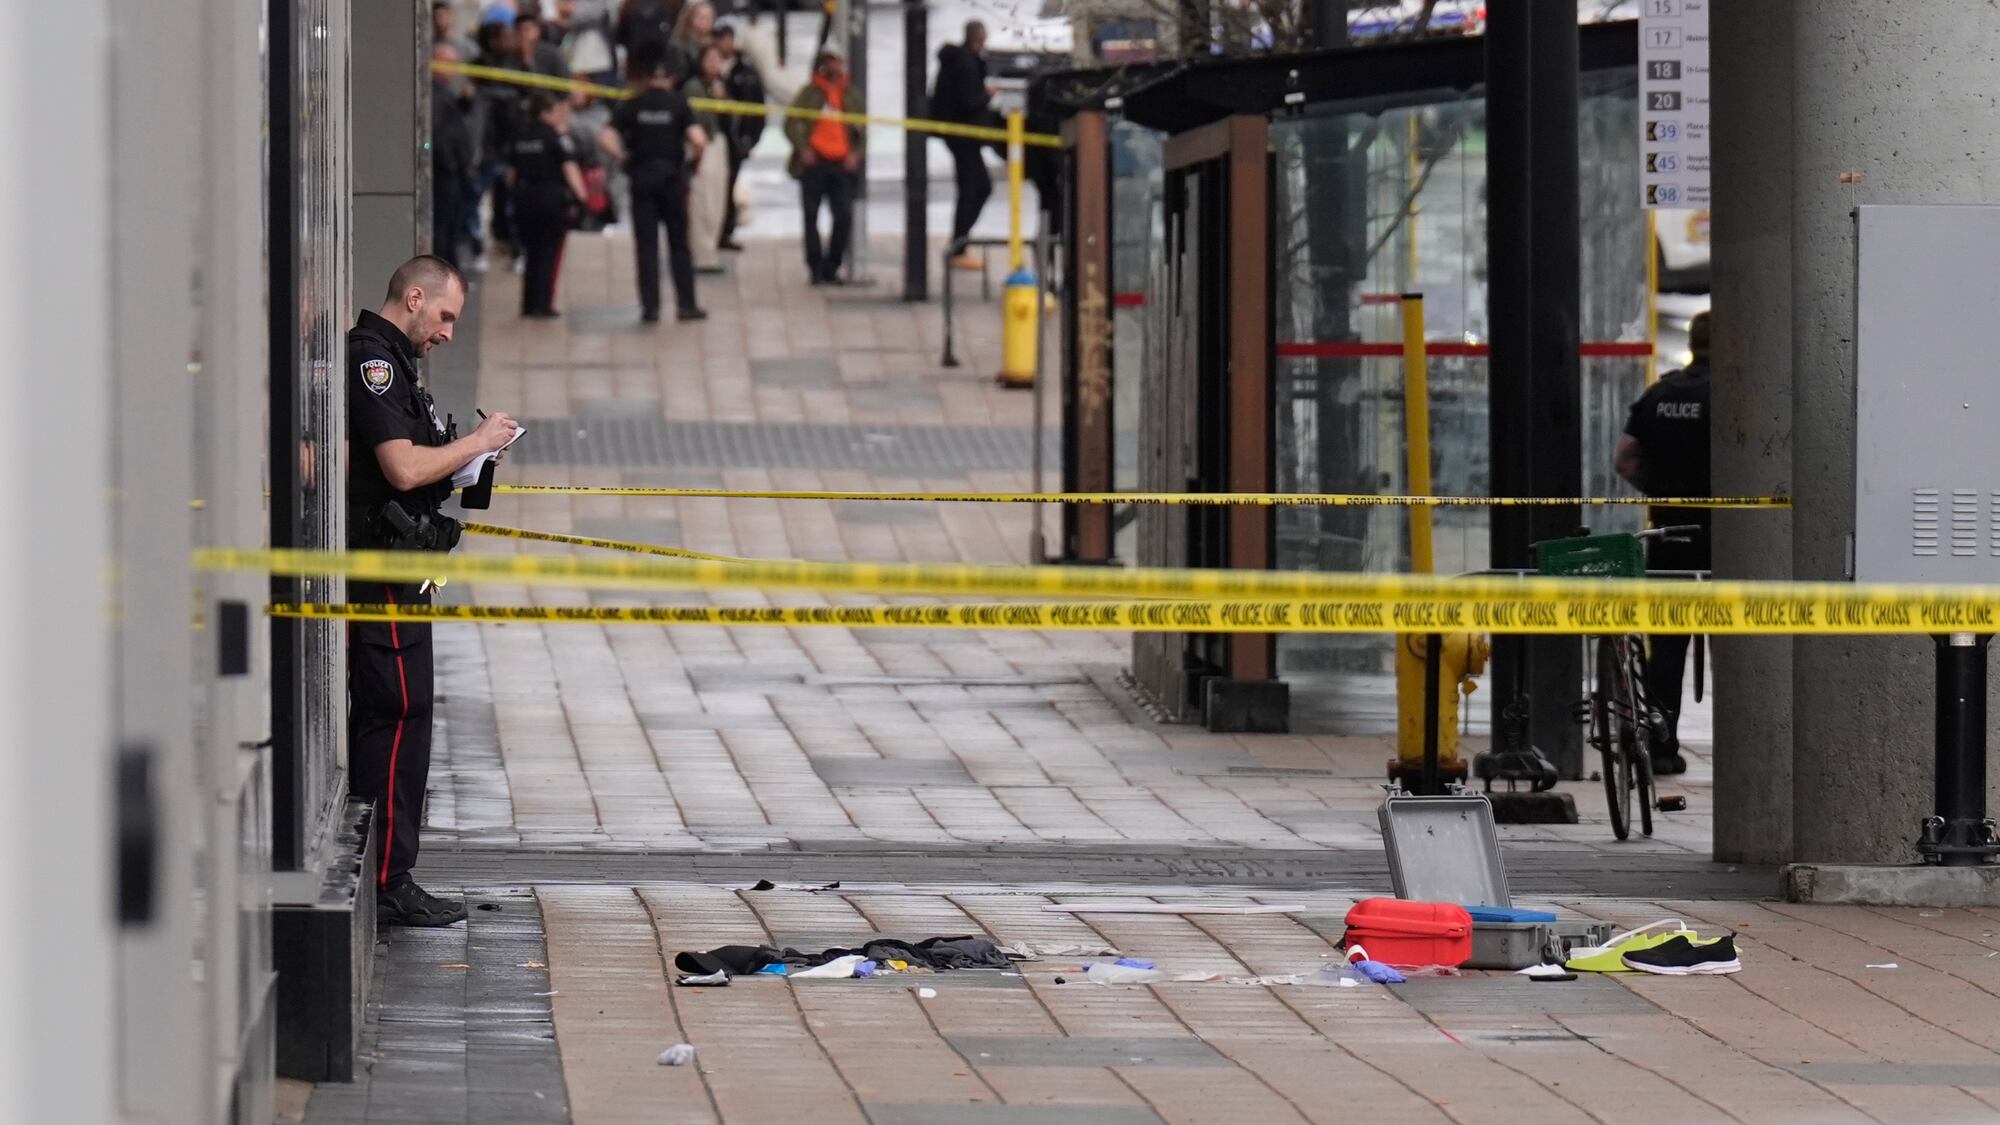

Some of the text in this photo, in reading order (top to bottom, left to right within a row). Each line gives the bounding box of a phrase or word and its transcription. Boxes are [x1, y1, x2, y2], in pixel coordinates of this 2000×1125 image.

[1654, 0, 1671, 13] 15
[1654, 31, 1671, 45] 17
[1653, 63, 1672, 78] 18
[1654, 93, 1673, 109] 20
[1658, 123, 1676, 138] 39
[1658, 155, 1676, 170] 45
[1658, 187, 1676, 202] 98
[365, 361, 389, 369] POLICE
[1656, 402, 1701, 419] POLICE
[1128, 605, 1146, 625] DO
[1147, 604, 1172, 625] NOT
[1173, 604, 1211, 625] CROSS
[1220, 603, 1263, 625] POLICE
[1263, 603, 1291, 625] LINE
[1300, 603, 1316, 625] DO
[1319, 603, 1343, 625] NOT
[1345, 603, 1383, 626] CROSS
[1393, 602, 1436, 626] POLICE
[1436, 602, 1464, 626] LINE
[1472, 602, 1489, 626] DO
[1492, 602, 1516, 626] NOT
[1518, 601, 1557, 626] CROSS
[1567, 601, 1610, 626] POLICE
[1612, 601, 1639, 626] LINE
[1648, 600, 1665, 626] DO
[1667, 600, 1691, 626] NOT
[1694, 600, 1733, 626] CROSS
[1744, 600, 1786, 625] POLICE
[1788, 600, 1815, 625] LINE
[1825, 600, 1841, 625] DO
[1845, 600, 1868, 625] NOT
[1871, 600, 1910, 625] CROSS
[1921, 600, 1963, 625] POLICE
[1965, 600, 1993, 625] LINE
